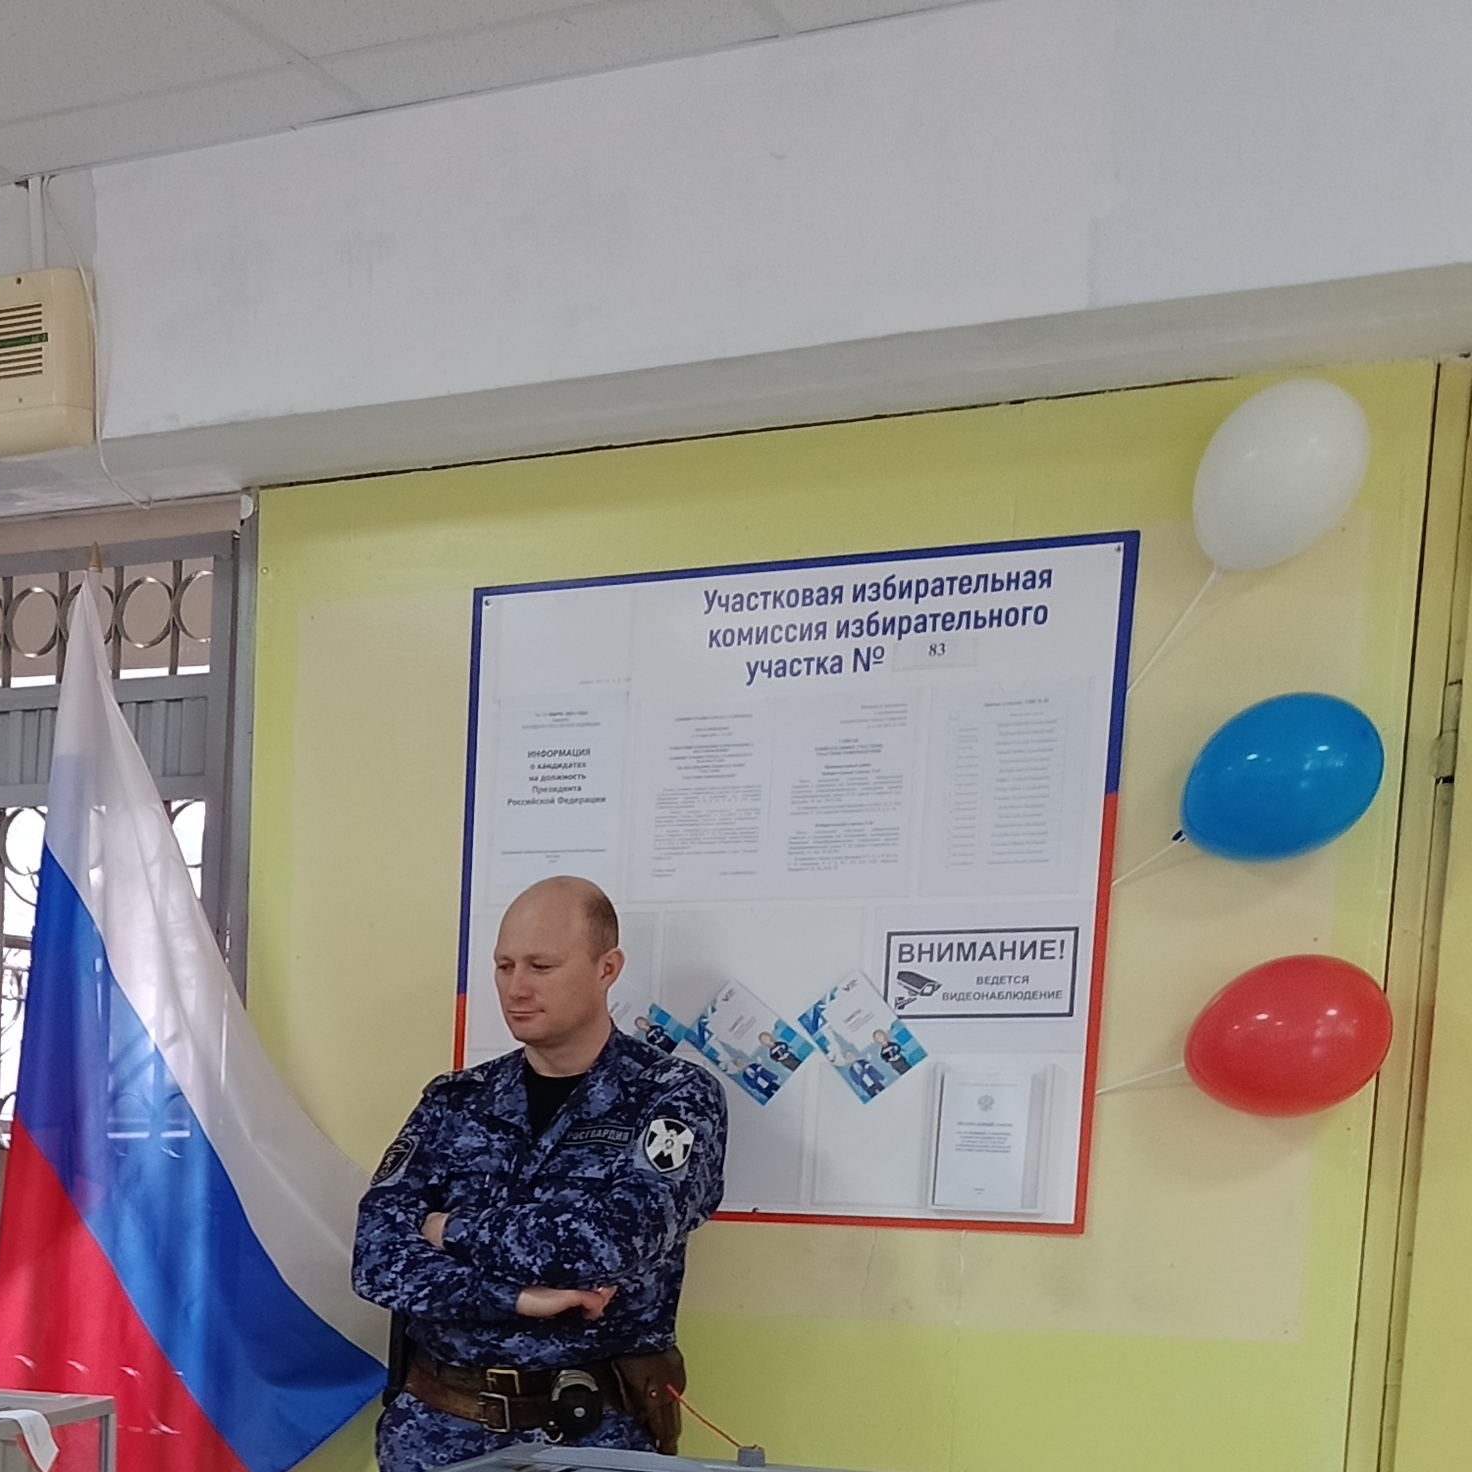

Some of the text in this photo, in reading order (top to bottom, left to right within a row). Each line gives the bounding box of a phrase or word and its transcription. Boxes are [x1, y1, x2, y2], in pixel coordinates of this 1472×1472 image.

[703, 568, 1053, 615] Участковая избирательная
[708, 604, 1049, 649] комиссия избирательного
[928, 643, 946, 657] 83
[746, 654, 844, 686] участка
[528, 748, 591, 759] ИНФОРМАЦИЯ
[537, 762, 587, 770] кандидатах
[540, 773, 587, 783] должность
[532, 785, 582, 794] Президента
[897, 938, 1066, 964] ВНИМАНИЕ!
[976, 975, 1030, 986] ВЕДЕТСЯ
[941, 990, 1063, 1002] ВИДЕОНАБЛЮДЕНИЕ
[565, 1128, 630, 1141] РОСГВАРДИЯ
